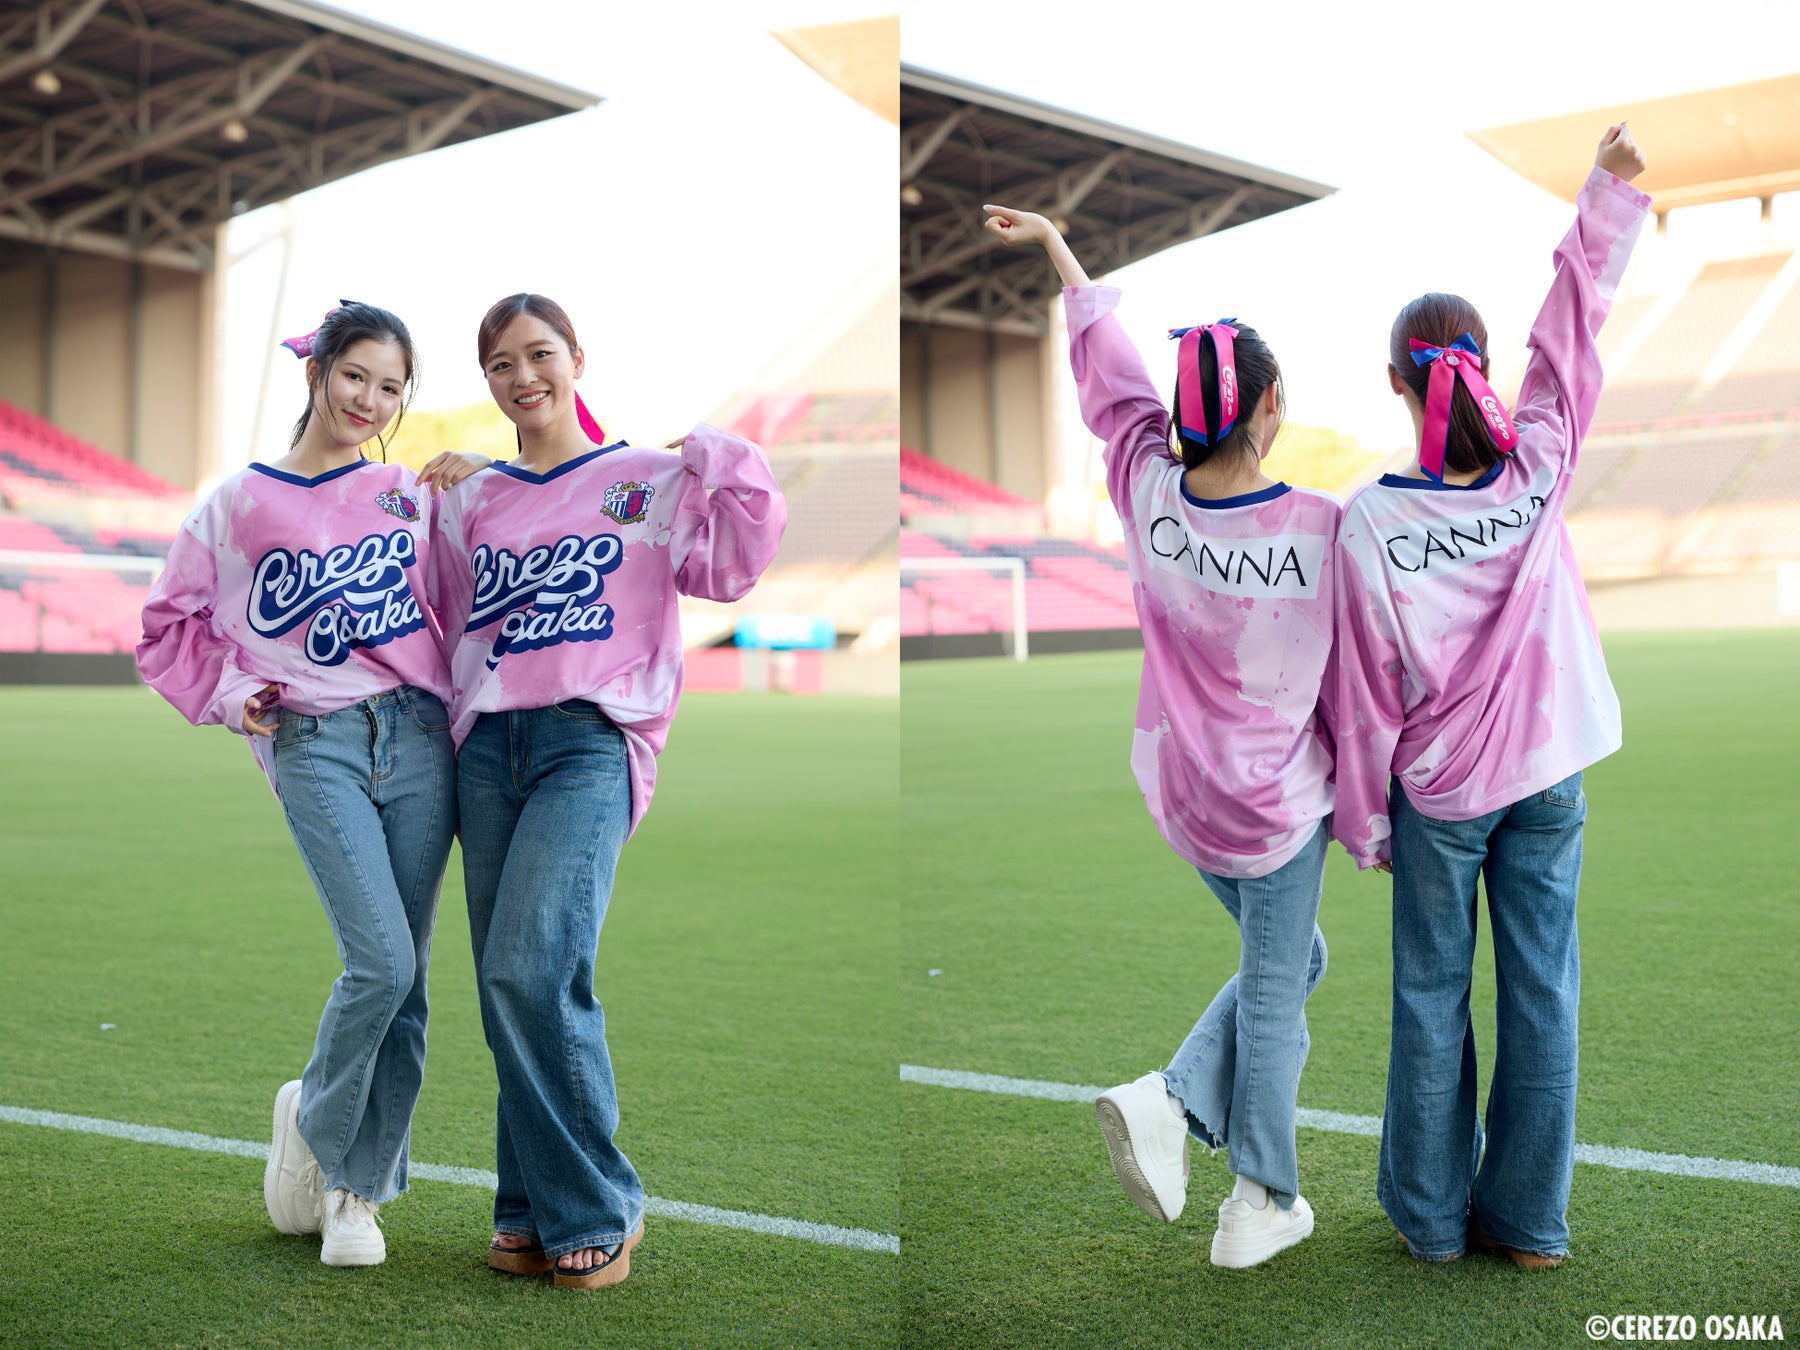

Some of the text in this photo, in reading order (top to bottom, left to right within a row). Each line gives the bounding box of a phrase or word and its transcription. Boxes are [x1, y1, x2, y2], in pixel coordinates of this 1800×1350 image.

[1481, 396, 1510, 440] Cerezo
[248, 530, 415, 637] Cerezo
[1150, 516, 1306, 587] CANNA
